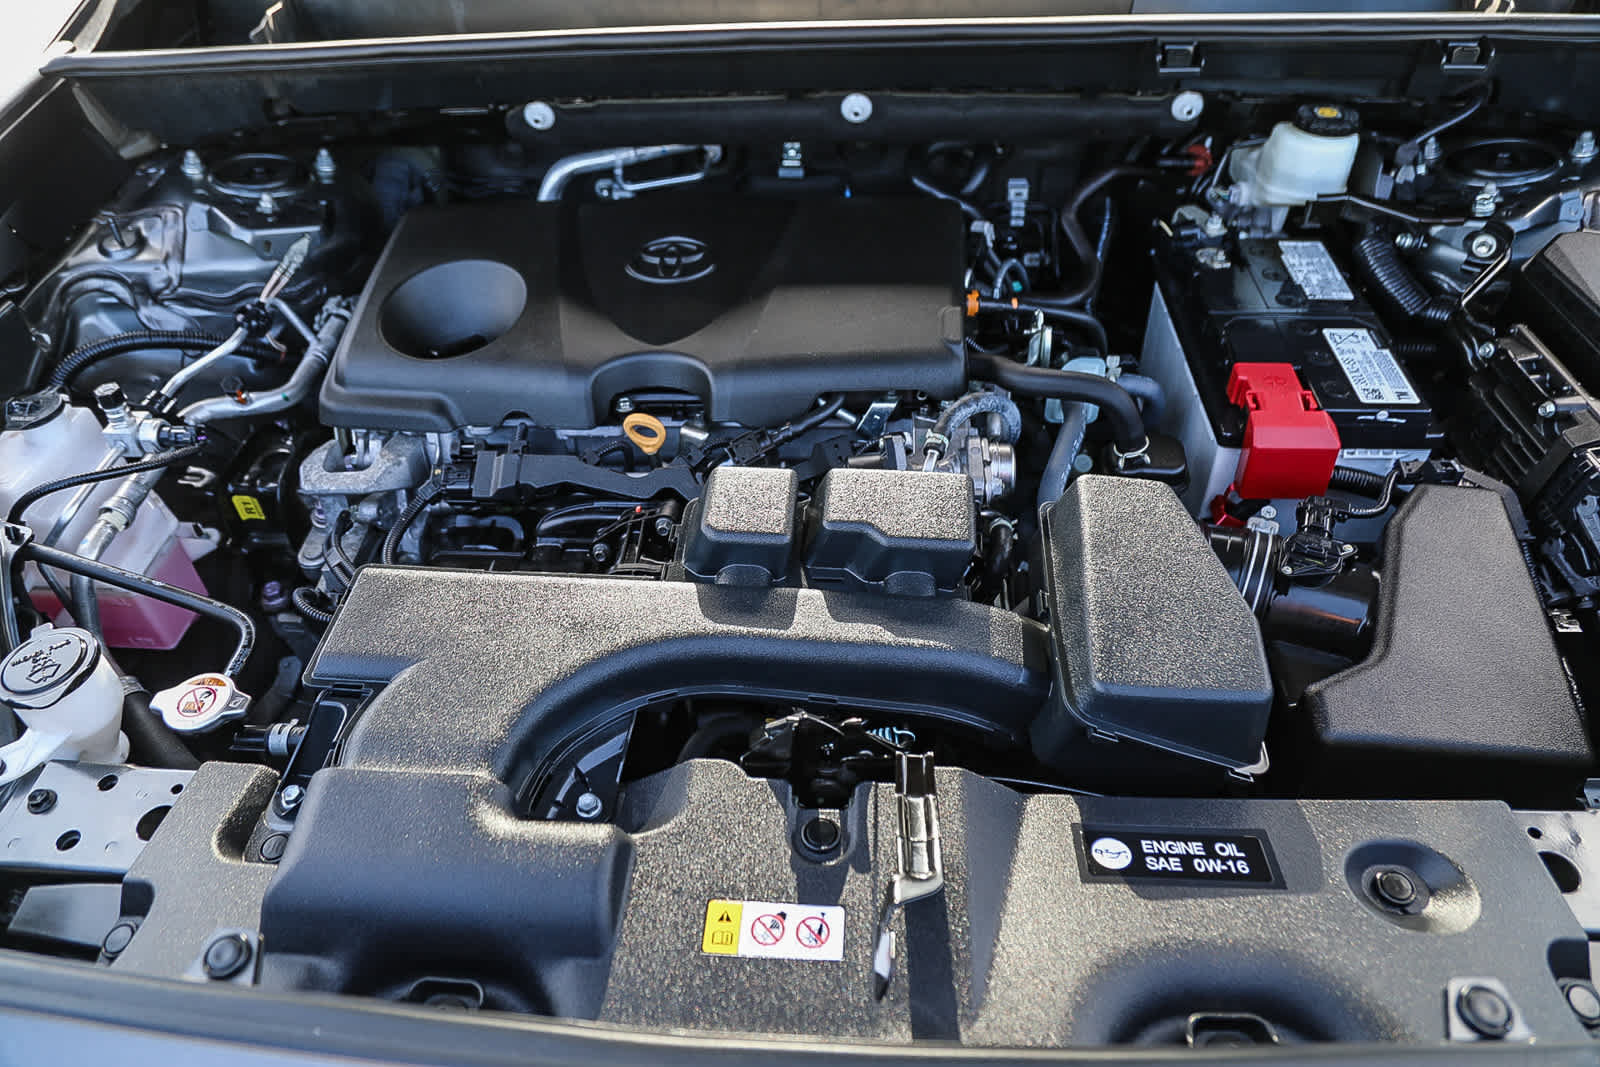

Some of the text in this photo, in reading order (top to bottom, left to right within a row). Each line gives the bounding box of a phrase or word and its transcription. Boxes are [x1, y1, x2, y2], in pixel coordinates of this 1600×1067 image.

[1140, 839, 1246, 857] ENGINE OIL
[1145, 857, 1250, 874] SAE 0W-16
